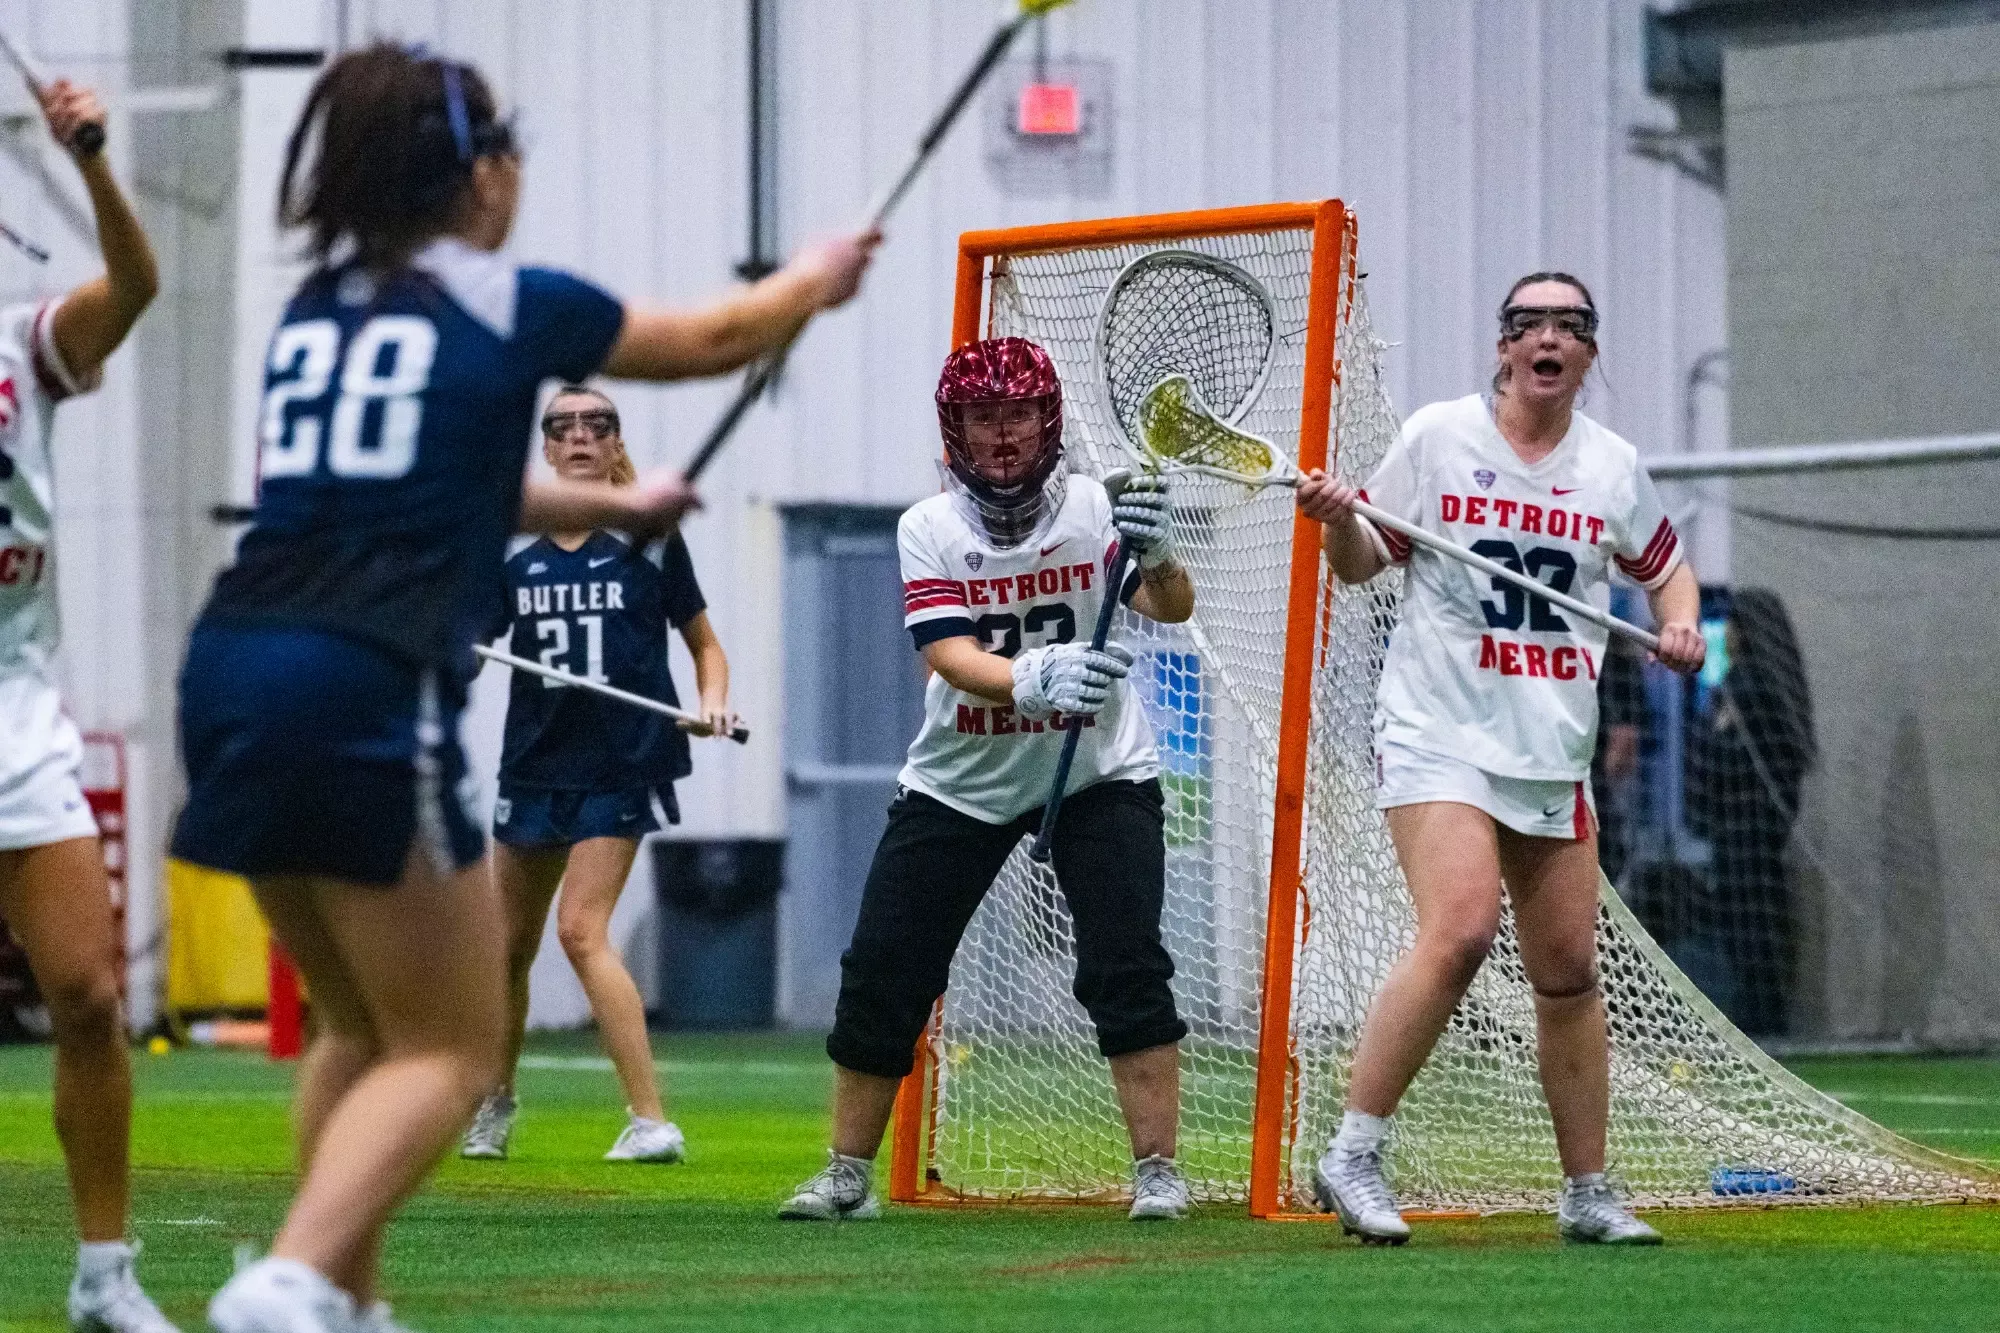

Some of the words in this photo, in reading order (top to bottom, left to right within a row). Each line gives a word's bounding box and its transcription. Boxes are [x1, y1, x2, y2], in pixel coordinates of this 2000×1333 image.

[261, 315, 440, 479] 28
[1441, 494, 1604, 545] DETROIT
[517, 581, 625, 615] BUTLER
[958, 562, 1094, 605] ETROIT
[1469, 539, 1577, 632] 32
[536, 615, 609, 688] 21
